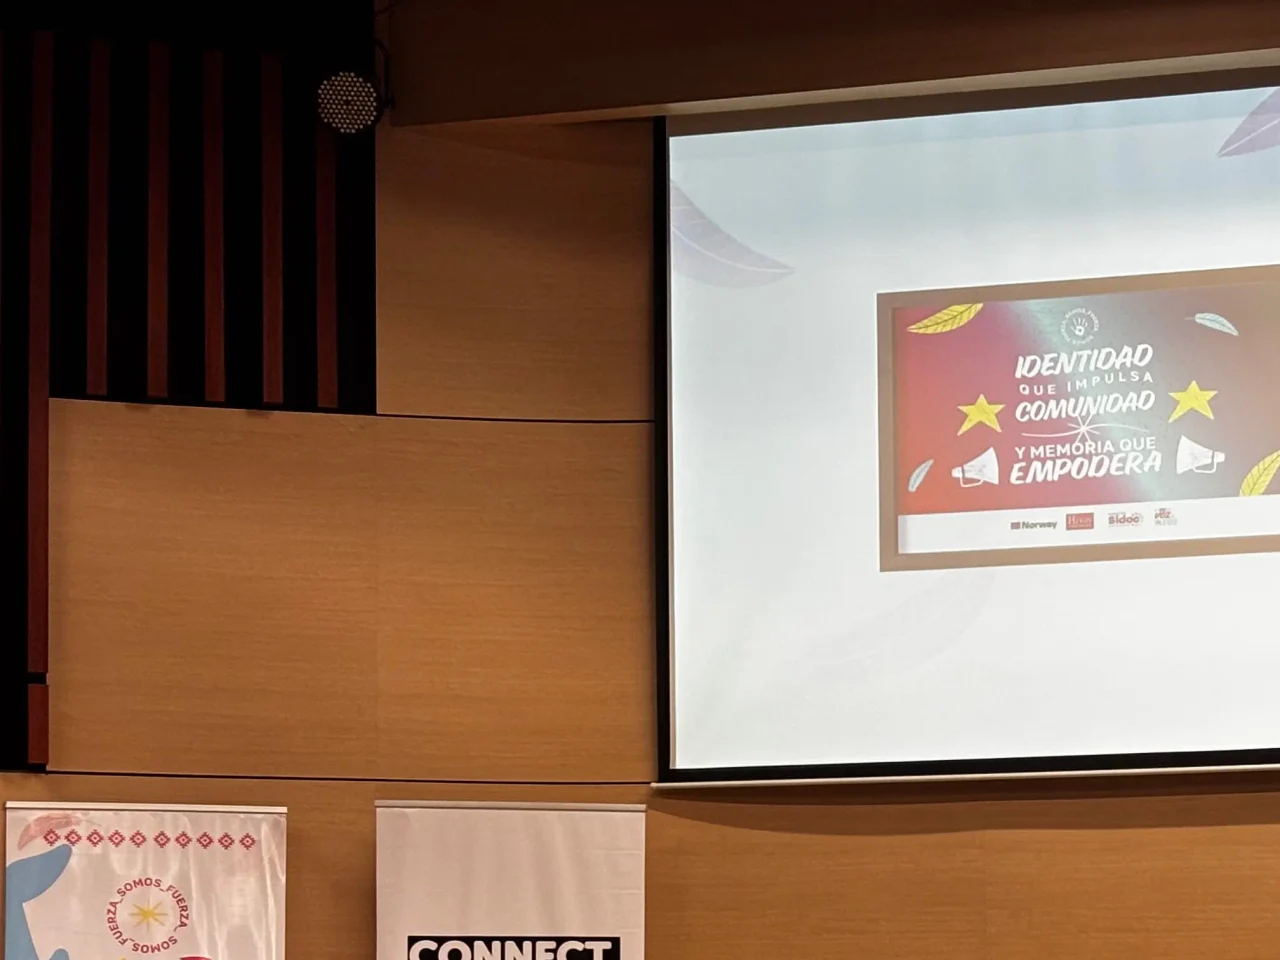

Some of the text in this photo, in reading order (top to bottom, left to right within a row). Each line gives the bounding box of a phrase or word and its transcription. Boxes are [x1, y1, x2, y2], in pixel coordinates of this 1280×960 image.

[1015, 344, 1153, 379] IDENTIDAD
[1019, 371, 1154, 395] QUE IMPULSA
[1015, 390, 1156, 422] COMUNIDAD
[1015, 436, 1156, 459] Y MEMORIA QUE
[1010, 450, 1162, 485] EMPODERA
[1021, 520, 1057, 530] Norway
